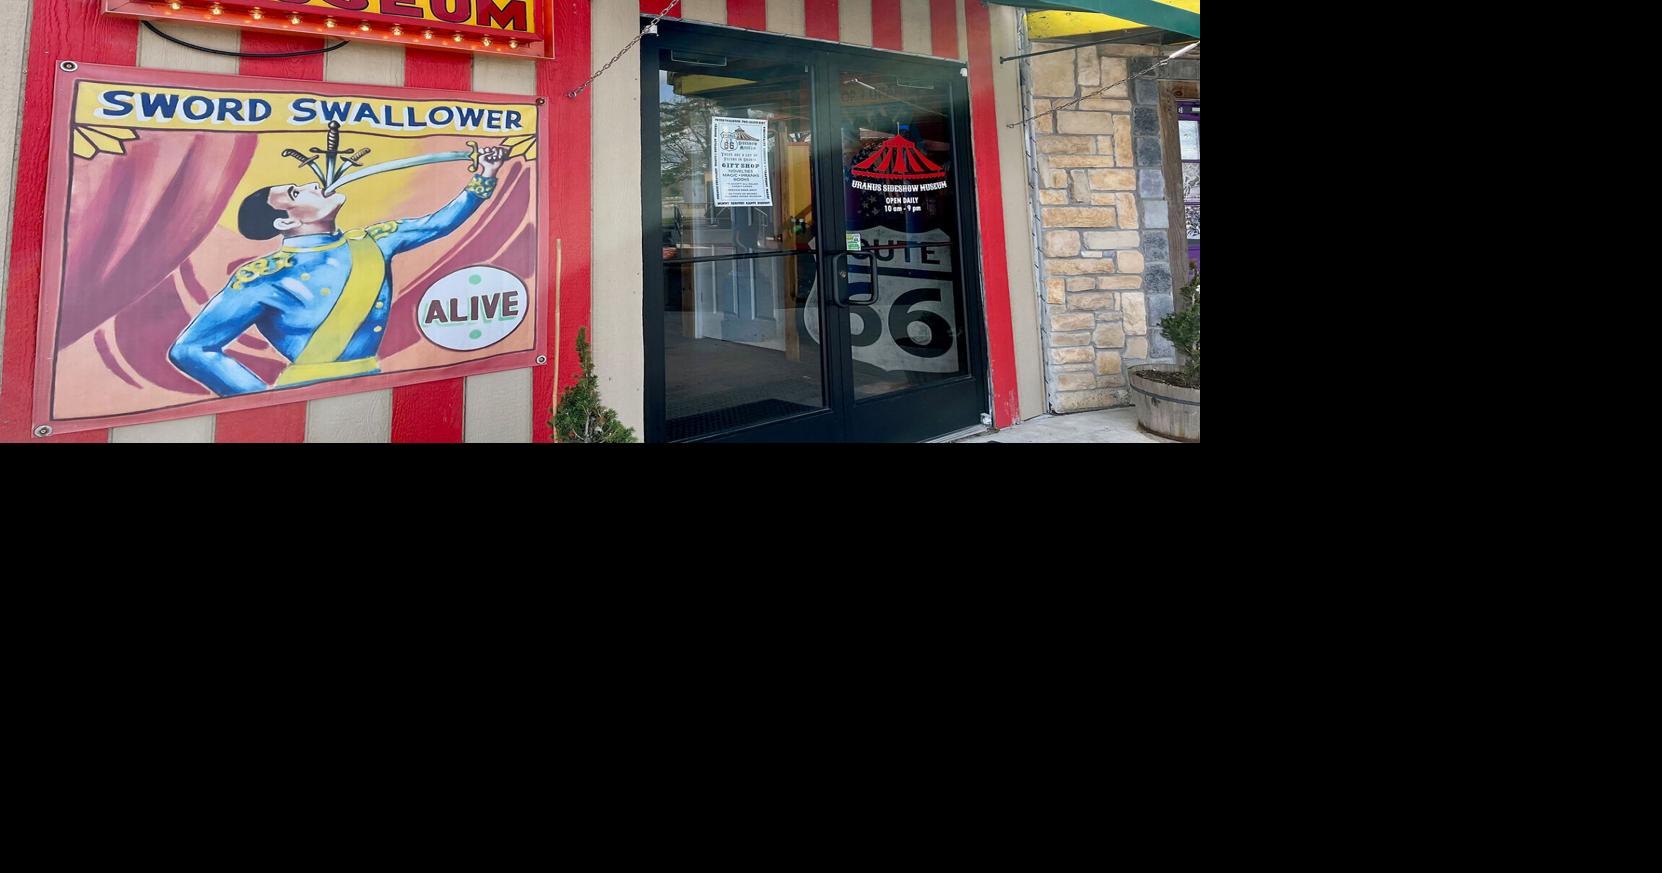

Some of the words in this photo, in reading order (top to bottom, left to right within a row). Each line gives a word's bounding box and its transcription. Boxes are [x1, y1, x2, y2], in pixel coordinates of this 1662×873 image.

[101, 90, 273, 123] SWORD
[291, 97, 523, 130] SWALLOWER
[851, 179, 882, 192] URANUS
[882, 184, 919, 193] SIDESHOW
[919, 180, 948, 192] MUSEUM
[424, 290, 519, 324] ALIVE
